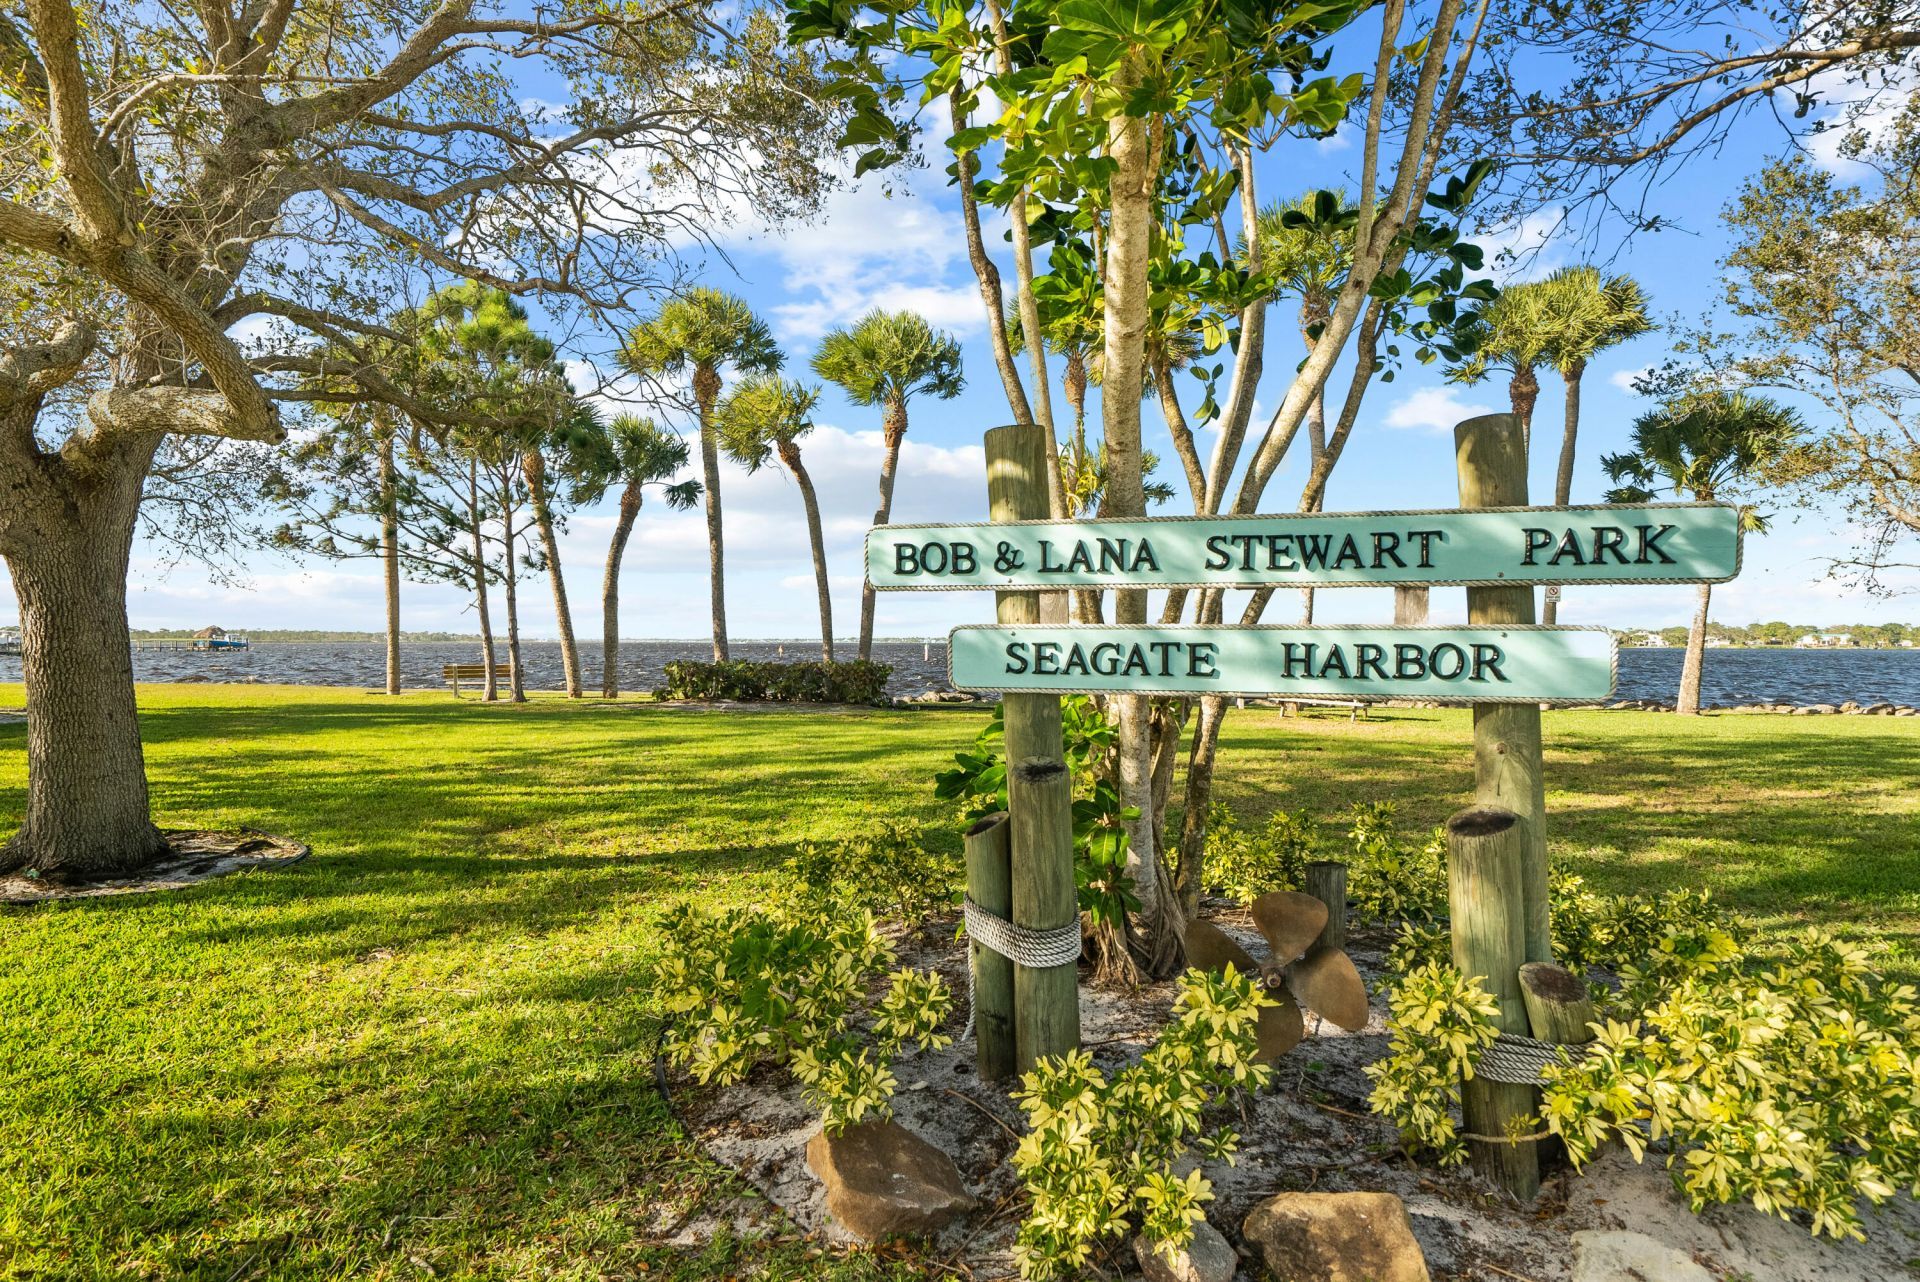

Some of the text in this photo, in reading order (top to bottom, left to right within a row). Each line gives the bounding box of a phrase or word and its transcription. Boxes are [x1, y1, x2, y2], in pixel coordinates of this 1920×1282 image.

[893, 524, 1677, 576] BOB & LANA STEWART PARK
[1005, 641, 1511, 681] SEAGATE HARBOR
